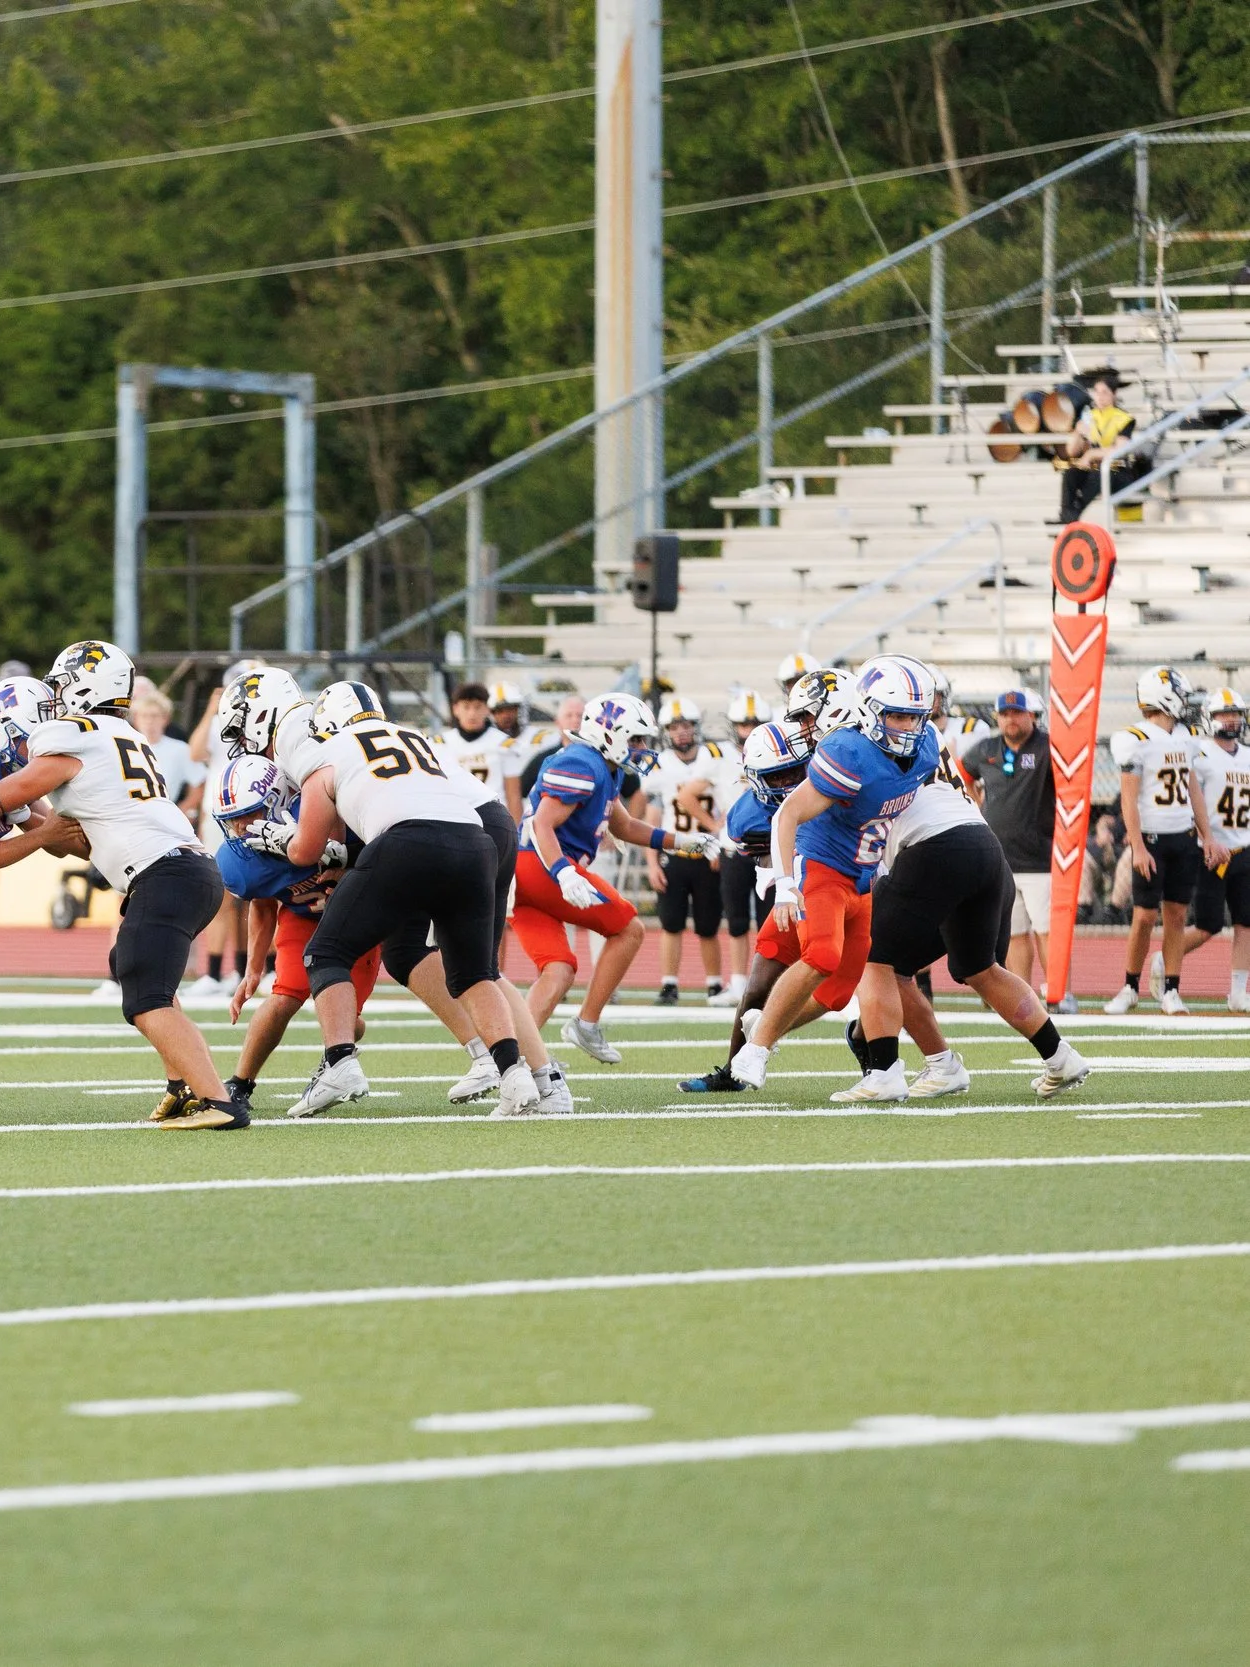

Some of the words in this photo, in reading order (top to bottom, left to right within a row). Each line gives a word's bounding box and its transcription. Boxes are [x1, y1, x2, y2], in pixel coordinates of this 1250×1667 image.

[595, 700, 626, 731] N
[1021, 754, 1035, 769] N
[248, 762, 278, 797] Bruin
[879, 791, 915, 816] BRUINS
[1217, 786, 1250, 829] 42
[287, 876, 318, 896] BRUI
